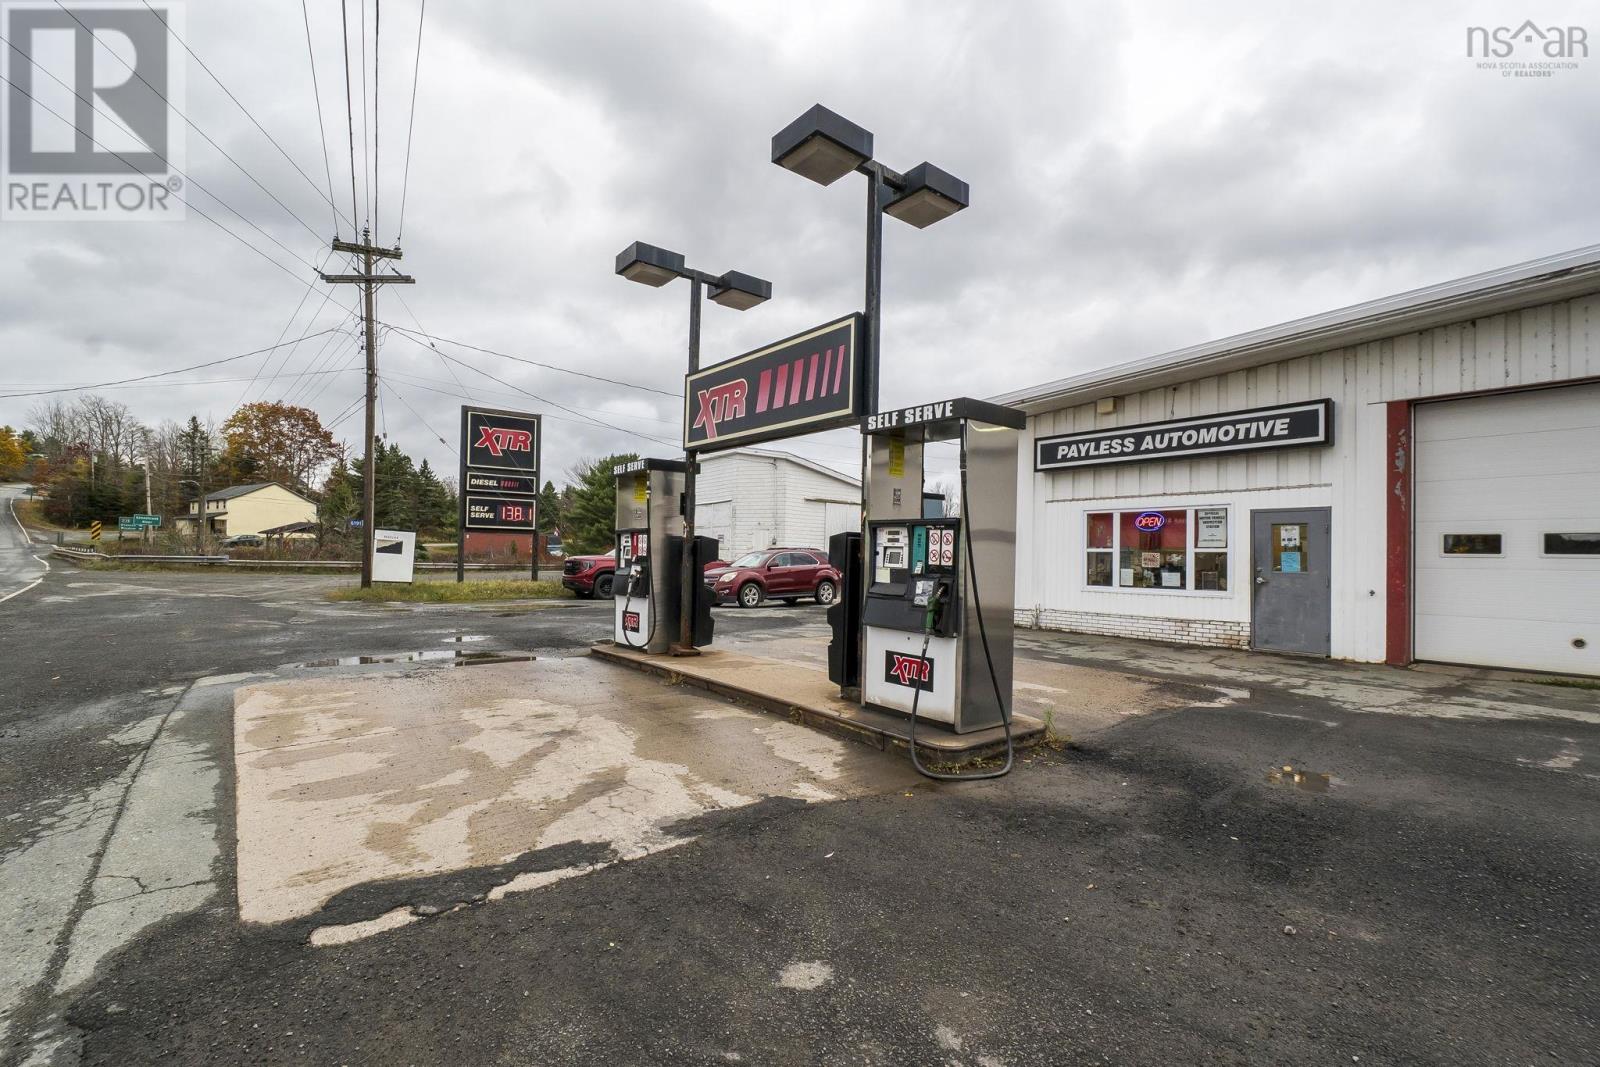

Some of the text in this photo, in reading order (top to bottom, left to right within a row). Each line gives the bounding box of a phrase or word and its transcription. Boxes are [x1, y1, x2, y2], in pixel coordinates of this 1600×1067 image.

[692, 378, 748, 441] XTR
[868, 401, 953, 430] SELF SERVE
[474, 426, 532, 456] XTR
[1056, 417, 1291, 460] PAYLESS AUTOMOTIVE
[470, 478, 499, 487] DIESEL
[1139, 516, 1162, 527] OPEN
[890, 654, 930, 685] XTR
